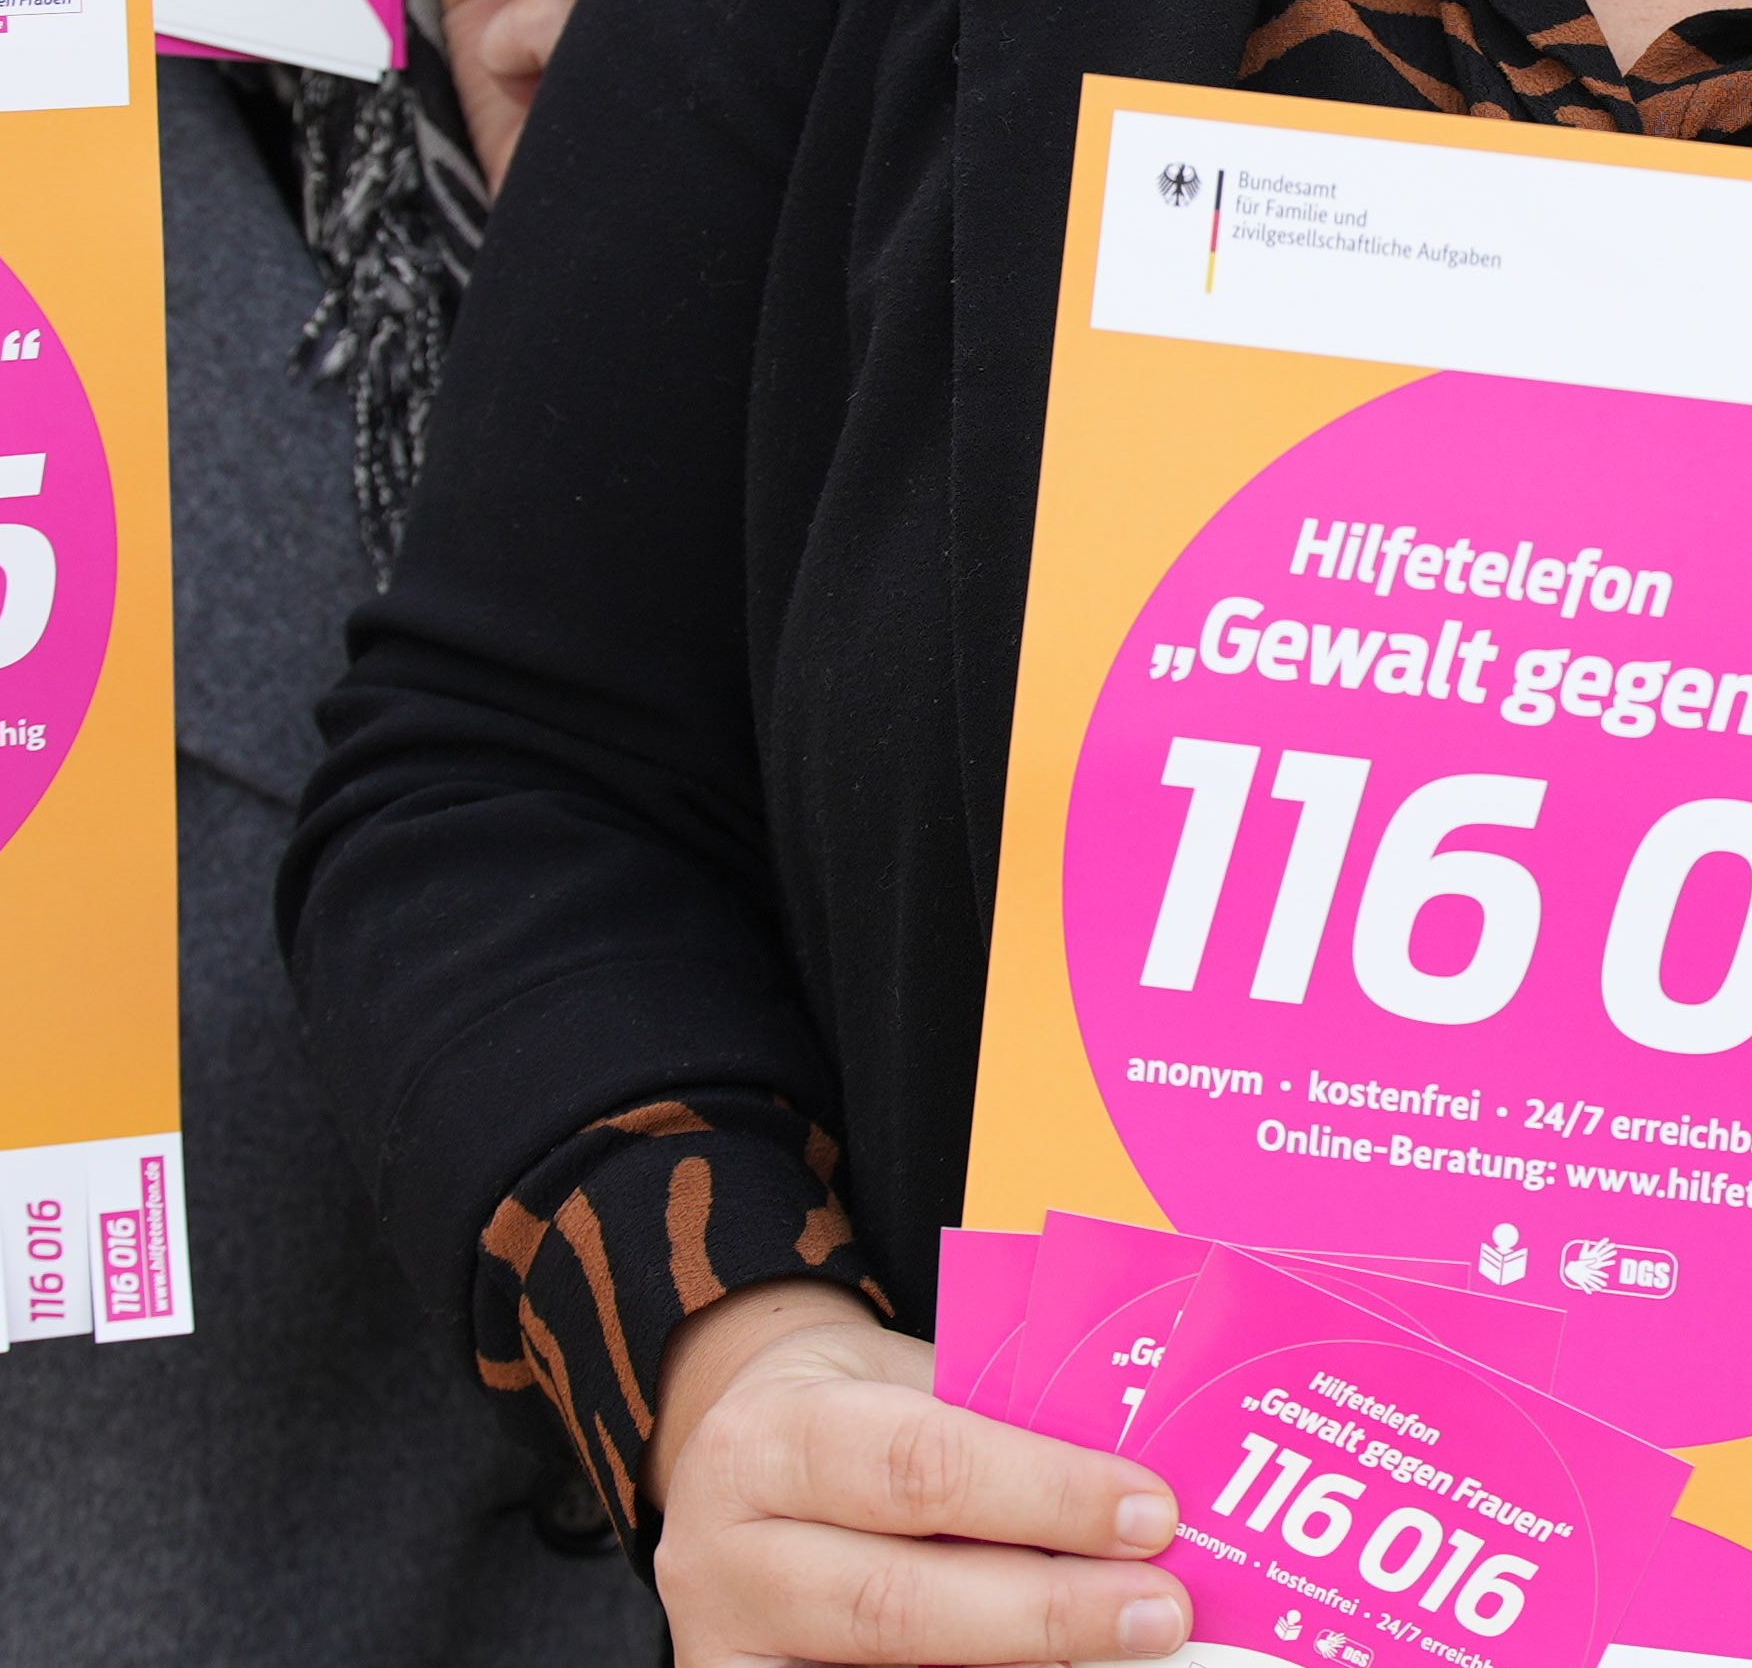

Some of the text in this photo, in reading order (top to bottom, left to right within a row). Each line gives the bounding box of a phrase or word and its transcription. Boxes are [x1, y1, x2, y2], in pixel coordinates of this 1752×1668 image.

[1235, 195, 1368, 228] für Familie und
[1237, 170, 1337, 200] Bundesamt
[1231, 221, 1502, 270] zivilgesellschaftliche Aufgaben
[1290, 518, 1673, 620] Hilfetelefon
[1149, 596, 1500, 704] „Gewalt
[1139, 736, 1548, 1025] 116
[1126, 1058, 1263, 1098] anonym
[1307, 1071, 1481, 1123] kostenfrei
[1523, 1097, 1605, 1138] 24/7
[1256, 1119, 1556, 1191] Online-Beratung:
[26, 1198, 66, 1323] 116 016
[105, 1215, 142, 1315] 116 016
[145, 1160, 170, 1313] www.hilfetelefon.de
[1619, 1255, 1671, 1290] DGS
[1309, 1370, 1440, 1446] Hilfetelefon
[1241, 1388, 1574, 1544] „Gewalt gegen Frauen“
[1175, 1523, 1247, 1567] anonym
[1266, 1561, 1360, 1617] kostenfrei
[1376, 1613, 1422, 1642] 24/7
[1211, 1432, 1540, 1638] 116 016
[1342, 1645, 1370, 1668] DGS
